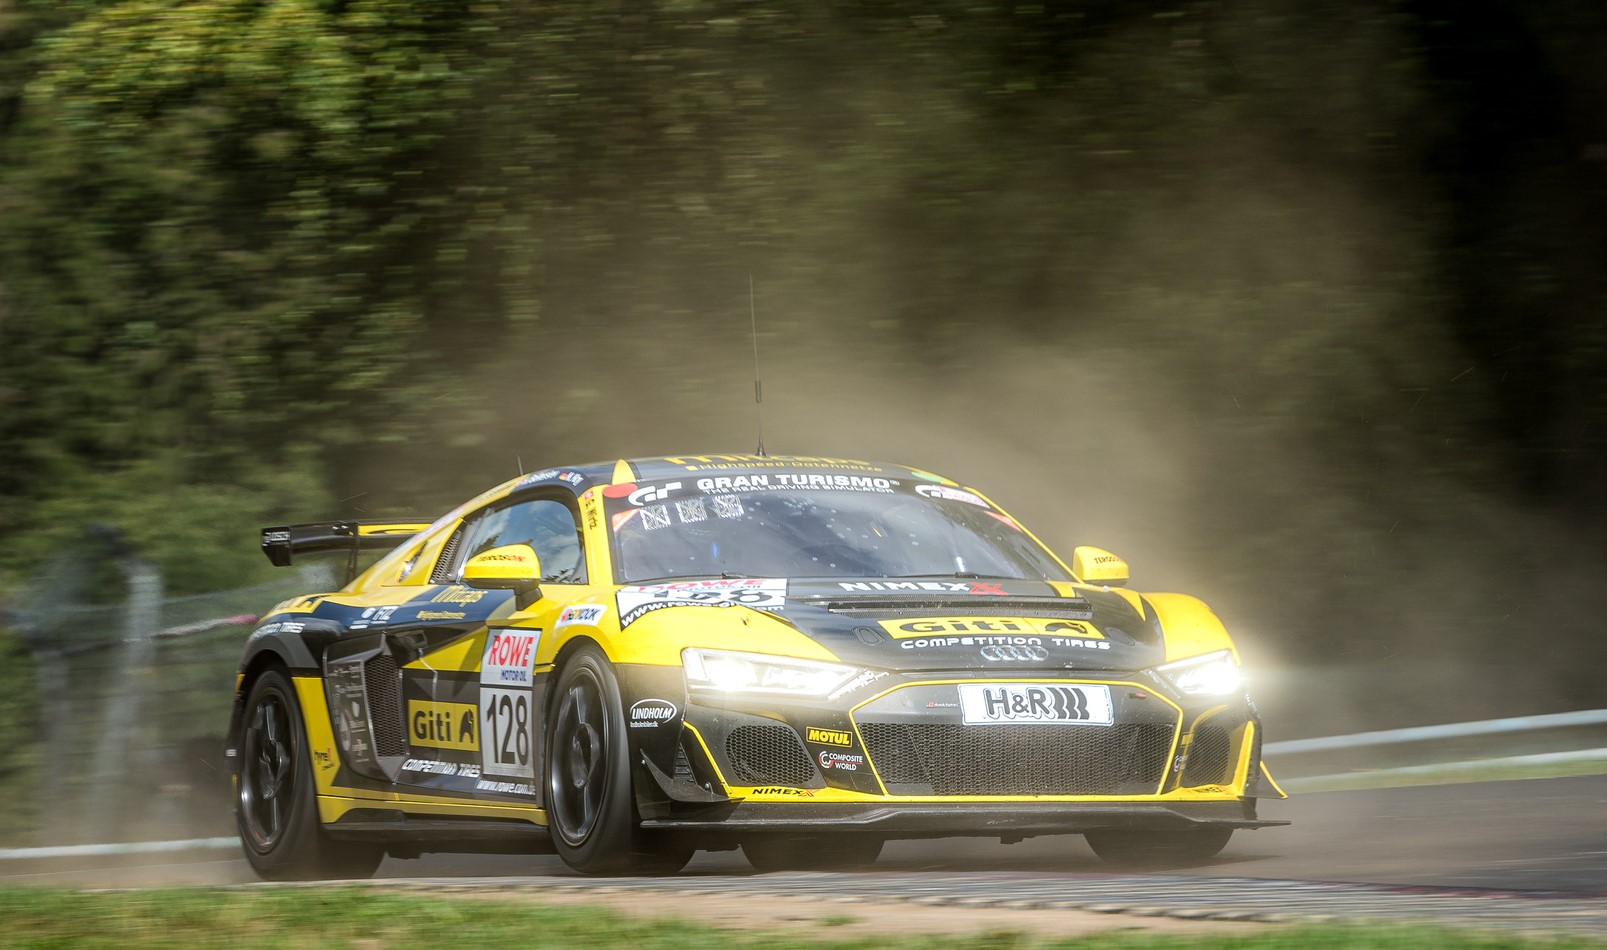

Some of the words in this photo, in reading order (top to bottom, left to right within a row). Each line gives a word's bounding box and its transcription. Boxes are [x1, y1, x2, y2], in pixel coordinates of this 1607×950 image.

[697, 475, 768, 490] GRAN
[775, 474, 891, 488] TURISMO
[703, 487, 730, 495] THE
[732, 485, 767, 493] REAL
[823, 484, 895, 494] SIMULATOR
[838, 582, 970, 592] NIMEX
[900, 620, 1021, 633] Giti
[901, 637, 1042, 649] COMPETITION
[1052, 638, 1111, 650] TIRES
[488, 635, 534, 667] ROWE
[983, 688, 1053, 718] H&R
[632, 707, 673, 719] LINDHOLM
[414, 710, 452, 741] Giti
[487, 694, 529, 766] 128
[809, 729, 850, 744] MOTUL
[829, 752, 863, 763] COMPOSITE
[835, 761, 857, 771] WORLD
[752, 788, 802, 796] NIMEX
